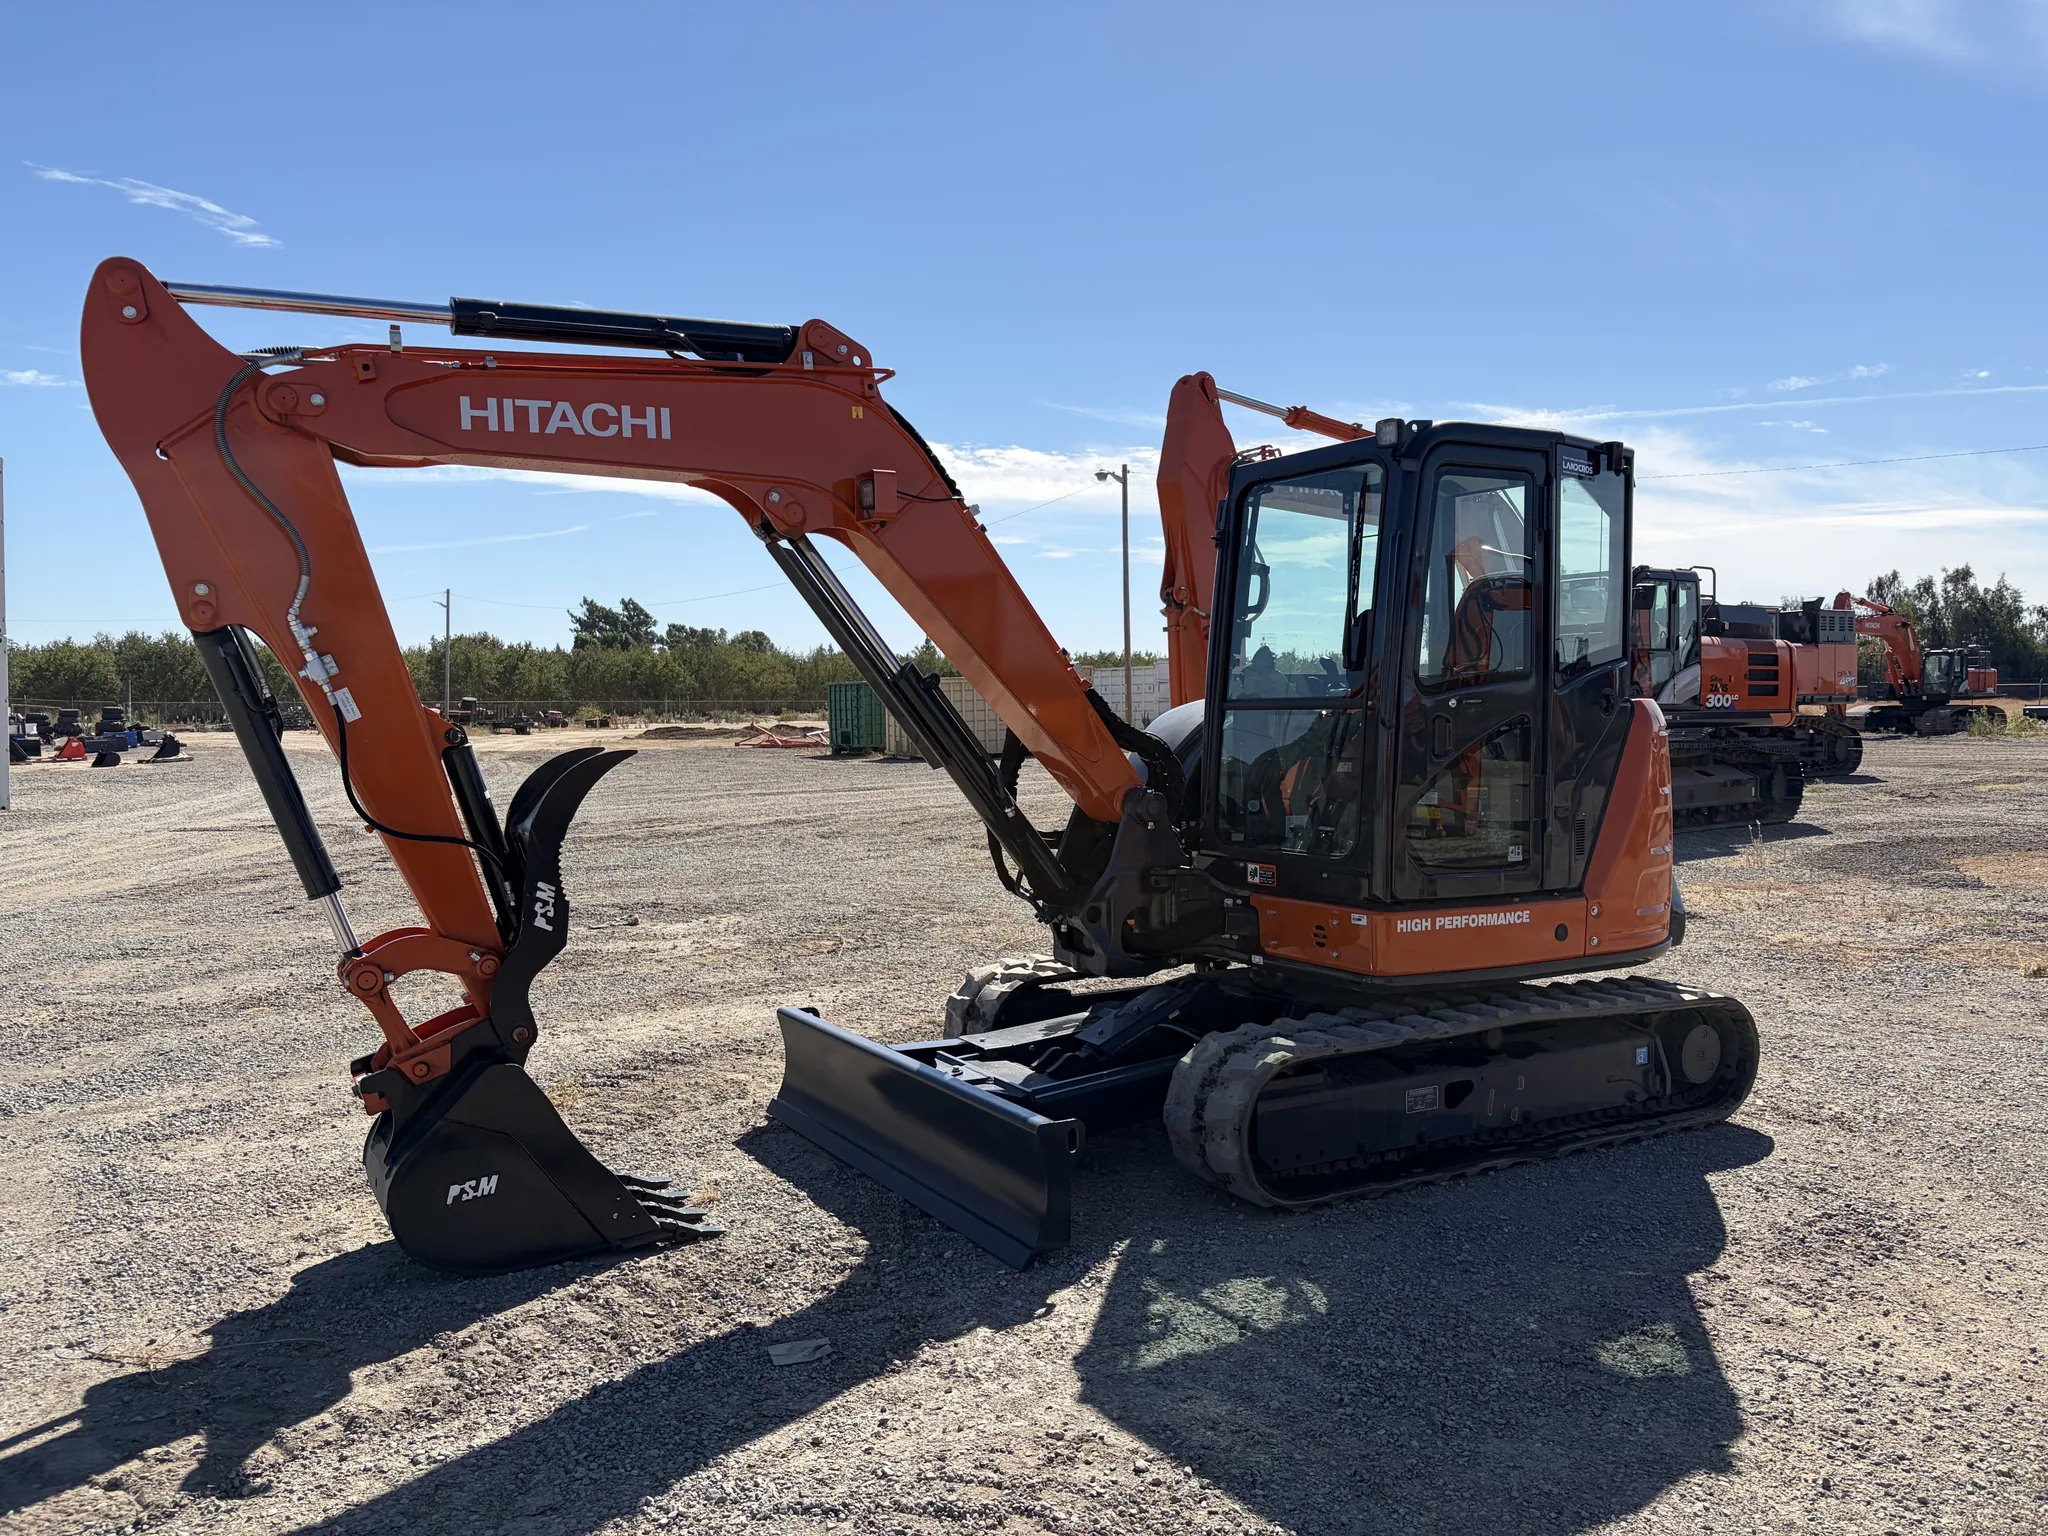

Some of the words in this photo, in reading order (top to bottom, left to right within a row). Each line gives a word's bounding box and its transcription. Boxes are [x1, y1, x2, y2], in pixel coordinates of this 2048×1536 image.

[459, 395, 672, 440] HITACHI
[1562, 460, 1593, 475] LANDCROS
[533, 881, 556, 932] PSM
[1396, 917, 1431, 933] HIGH
[1435, 910, 1531, 930] PERFORMANCE
[446, 1174, 499, 1205] PSM
